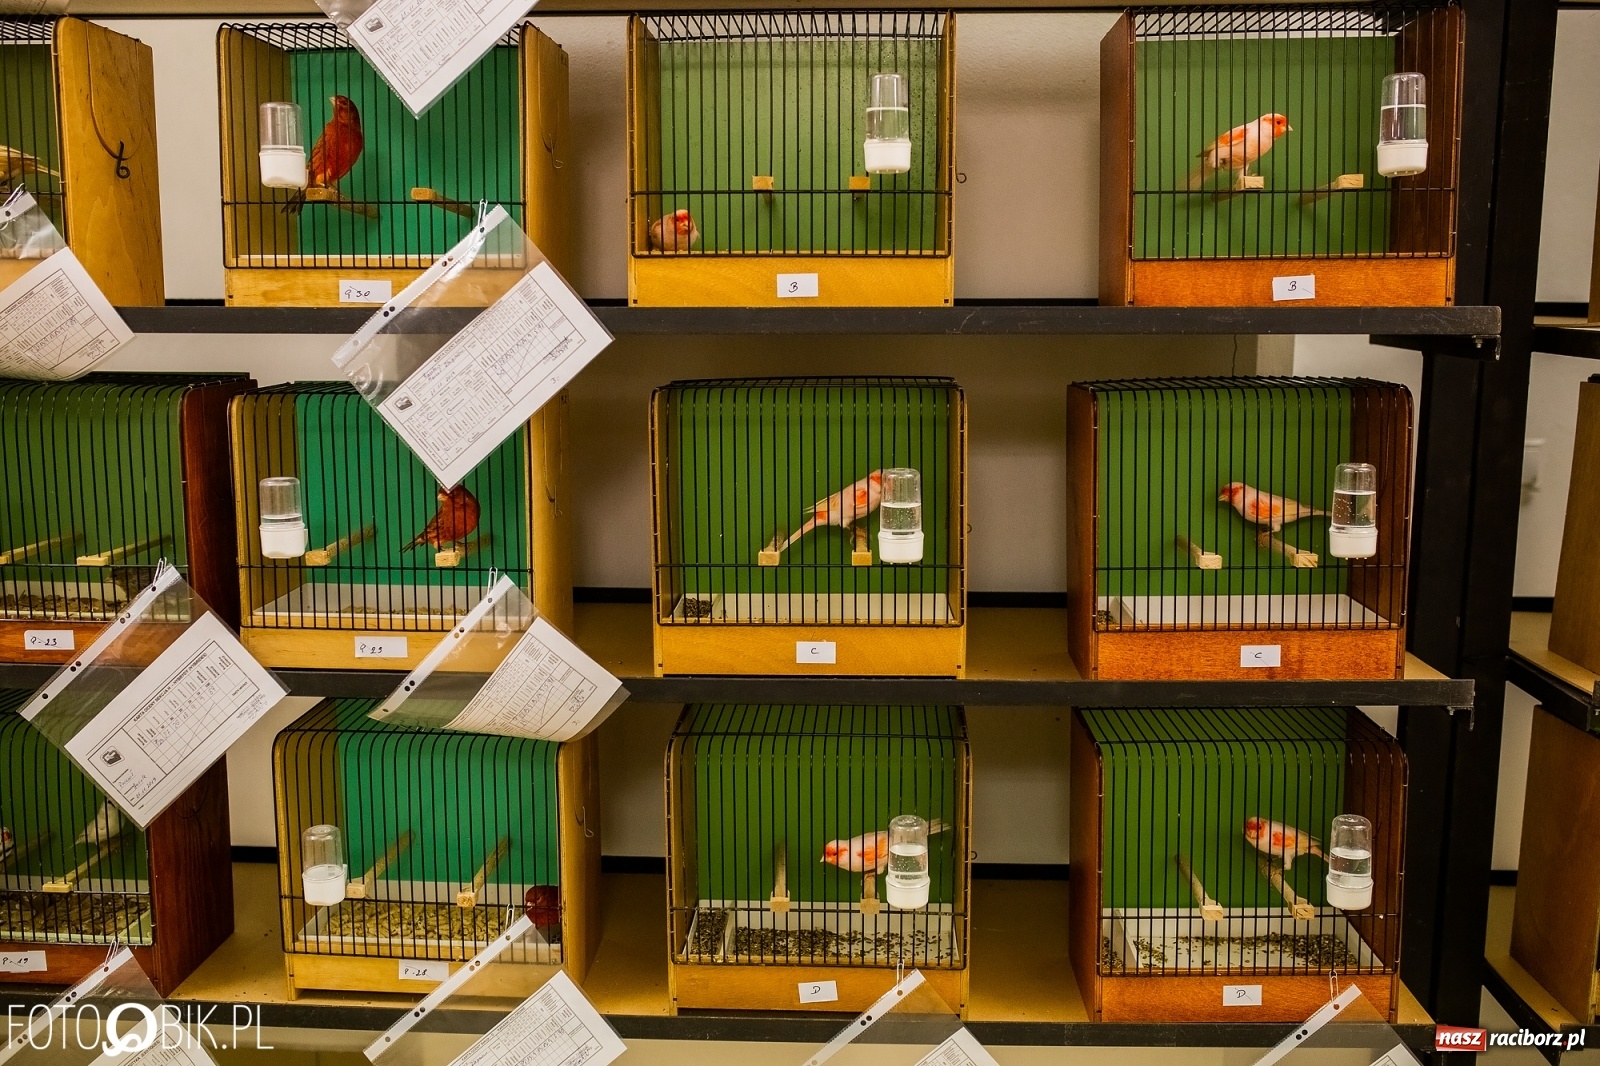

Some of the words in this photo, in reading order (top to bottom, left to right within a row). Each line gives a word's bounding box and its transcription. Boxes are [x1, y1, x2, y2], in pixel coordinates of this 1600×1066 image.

[788, 281, 799, 294] B
[1287, 280, 1298, 293] B
[809, 646, 820, 656] C
[810, 985, 821, 995] D
